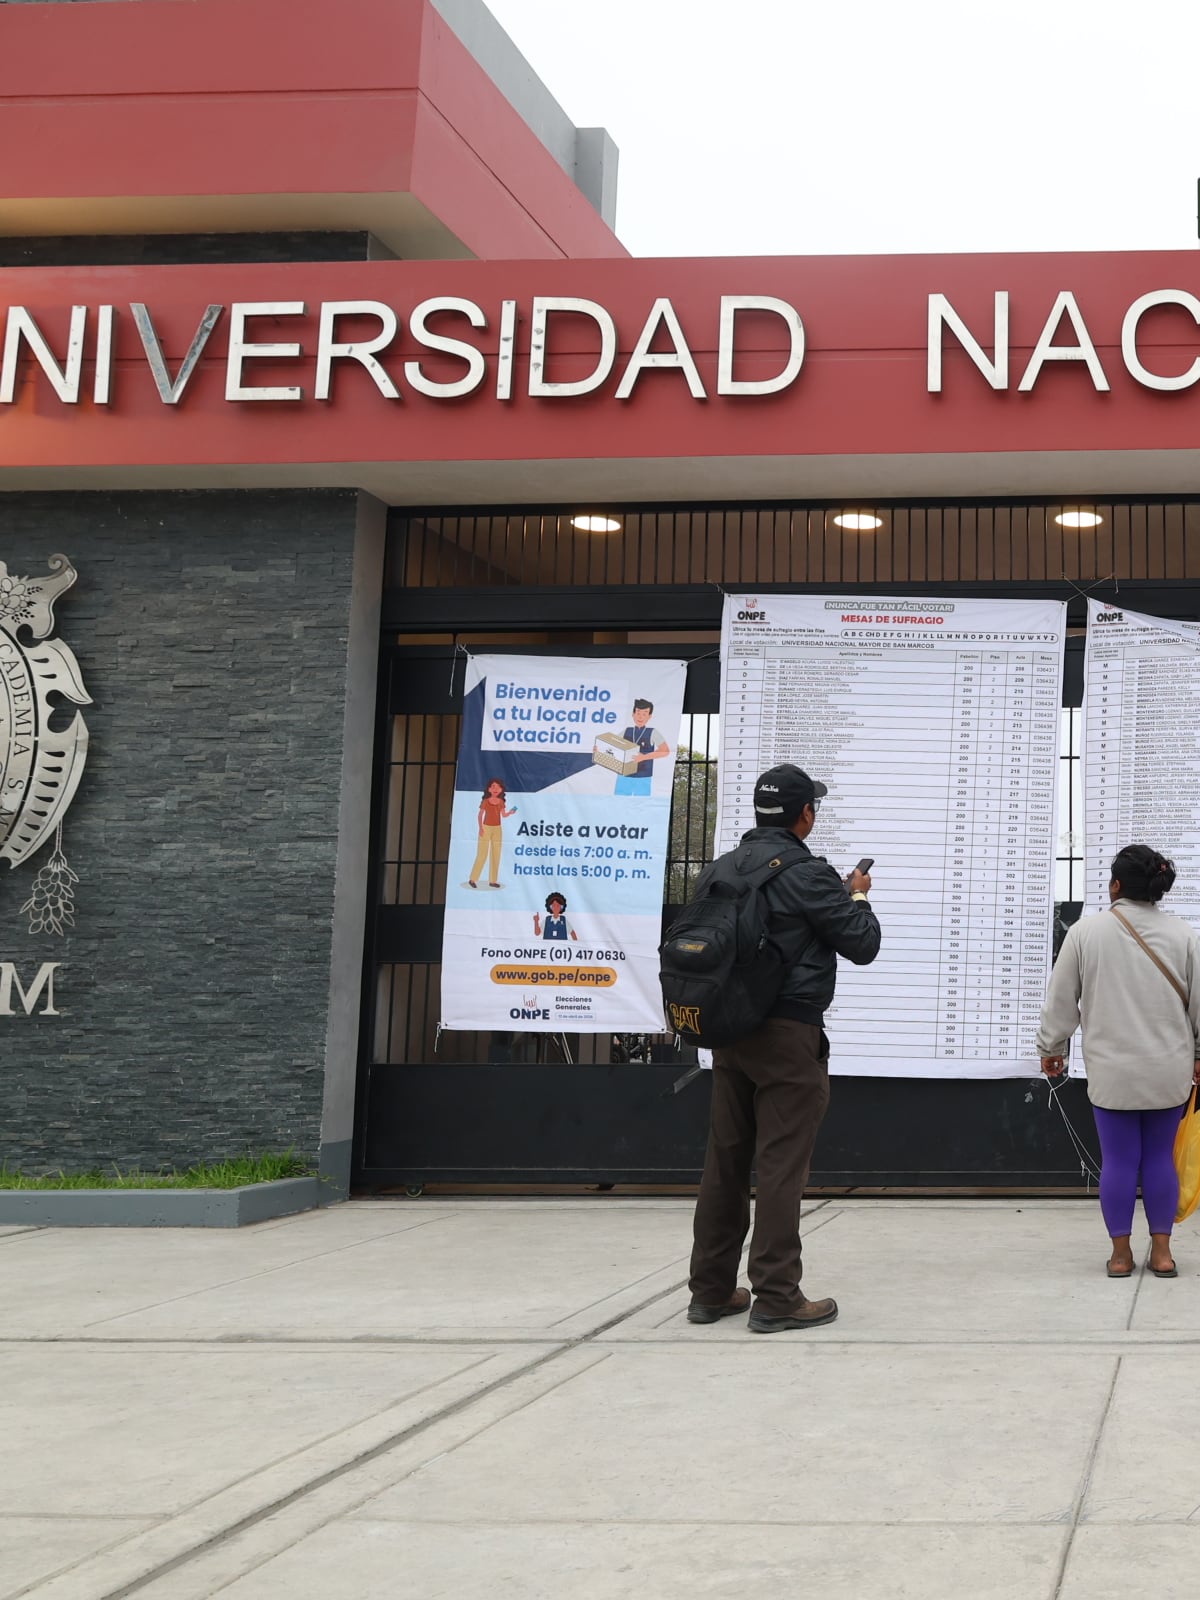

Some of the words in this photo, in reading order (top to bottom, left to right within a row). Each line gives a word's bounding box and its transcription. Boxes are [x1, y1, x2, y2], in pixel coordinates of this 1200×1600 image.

[826, 601, 859, 610] ¡NUNCA
[860, 602, 877, 610] FUE
[878, 603, 896, 611] TAN
[897, 602, 922, 612] FÁCIL
[923, 603, 954, 612] VOTAR!
[737, 611, 766, 621] ONPE
[841, 614, 873, 623] MESAS
[875, 615, 890, 624] DE
[892, 616, 944, 625] SUFRAGIO
[1096, 612, 1124, 622] ONPE
[1139, 637, 1180, 645] UNIVERSIDAD
[495, 682, 611, 702] Bienvenido
[493, 708, 506, 720] a
[511, 706, 531, 721] tu
[536, 706, 587, 723] local
[591, 708, 617, 723] de
[493, 726, 581, 744] votación
[516, 820, 573, 837] Asiste
[578, 825, 590, 838] a
[595, 824, 649, 839] votar
[514, 844, 557, 857] desde
[560, 845, 581, 858] las
[584, 846, 614, 858] 7:00
[617, 849, 630, 859] a.
[634, 850, 653, 860] m.
[513, 863, 553, 876] hasta
[557, 864, 578, 877] las
[581, 865, 611, 878] 5:00
[615, 868, 628, 882] p.
[631, 868, 651, 880] m.
[481, 948, 511, 958] Fono
[514, 948, 547, 960] ONPE
[550, 947, 572, 962] (01)
[576, 950, 593, 961] 417
[596, 950, 626, 961] 0630
[496, 968, 611, 984] www.gob.pe/onpe
[510, 1008, 550, 1020] ONPE
[669, 1003, 701, 1035] CAT
